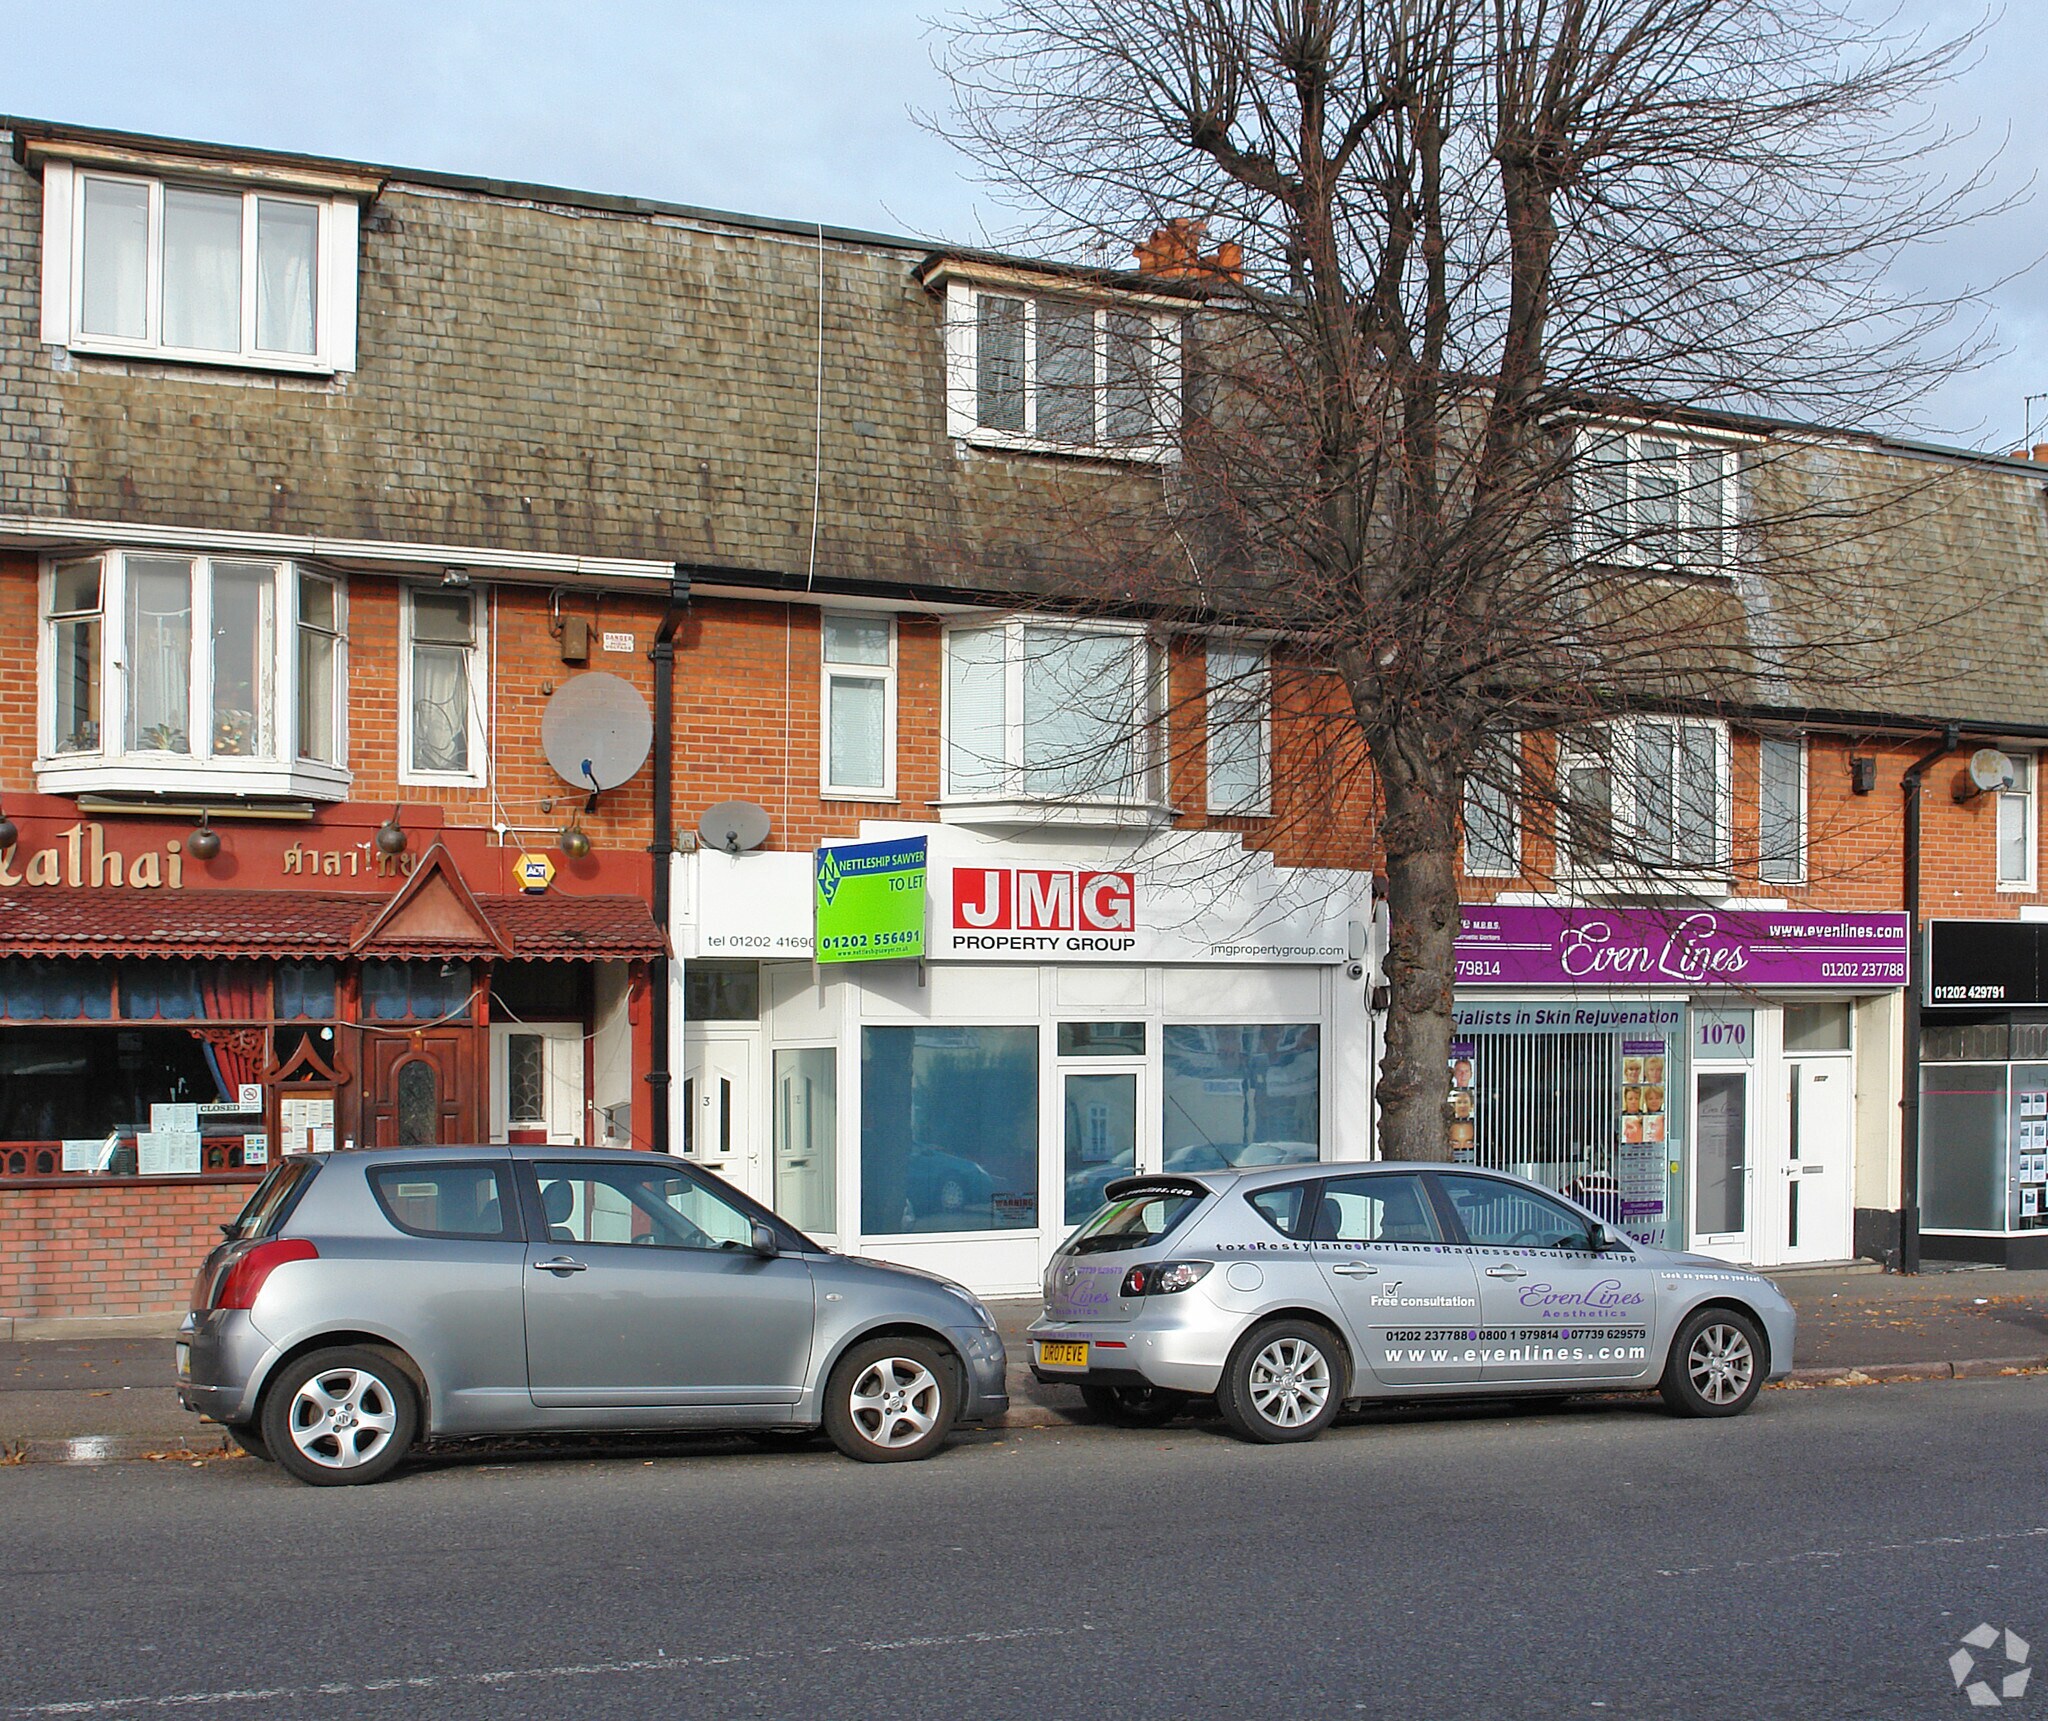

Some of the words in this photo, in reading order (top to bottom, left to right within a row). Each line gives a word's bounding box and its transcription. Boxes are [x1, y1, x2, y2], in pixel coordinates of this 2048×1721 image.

[839, 856, 890, 872] NETTLESHIP
[892, 850, 925, 866] SAWYER
[888, 877, 905, 892] TO
[907, 874, 924, 890] LET
[960, 868, 1132, 931] JMG
[822, 935, 868, 949] 01202
[874, 929, 920, 946] 556491
[1768, 923, 1905, 939] www.evenlines.com
[708, 935, 726, 947] tel
[729, 935, 772, 948] 01202
[952, 935, 1059, 951] PROPERTY
[1066, 936, 1136, 952] GROUP
[1209, 943, 1344, 959] jmgpropertygroup.com
[1454, 960, 1501, 976] 79814
[1821, 962, 1859, 978] 01202
[1861, 962, 1905, 978] 237788
[1934, 985, 1967, 1000] 01202
[1968, 985, 2005, 1000] 429791
[1515, 1009, 1531, 1025] in
[1535, 1009, 1571, 1025] Skin
[1574, 1008, 1680, 1027] Rejuvenation
[1700, 1023, 1747, 1046] 1070
[200, 1104, 240, 1113] CLOSED
[702, 1096, 711, 1107] 3
[994, 1198, 1034, 1207] WARNING
[1216, 1242, 1247, 1252] tox
[1661, 1271, 1681, 1279] Look
[1694, 1273, 1719, 1281] young
[1370, 1296, 1399, 1307] Free
[1400, 1296, 1476, 1307] consultation
[1542, 1309, 1628, 1318] Aesthetics
[1385, 1330, 1422, 1341] 01202
[1424, 1330, 1469, 1341] 237788
[1478, 1330, 1508, 1341] 0800
[1511, 1330, 1516, 1340] 1
[1519, 1329, 1559, 1340] 979814
[1570, 1329, 1605, 1340] 07739
[1606, 1329, 1647, 1340] 629579
[1044, 1345, 1065, 1362] DR07
[1066, 1345, 1084, 1362] EVE
[1384, 1344, 1647, 1362] www.evenlines.com
